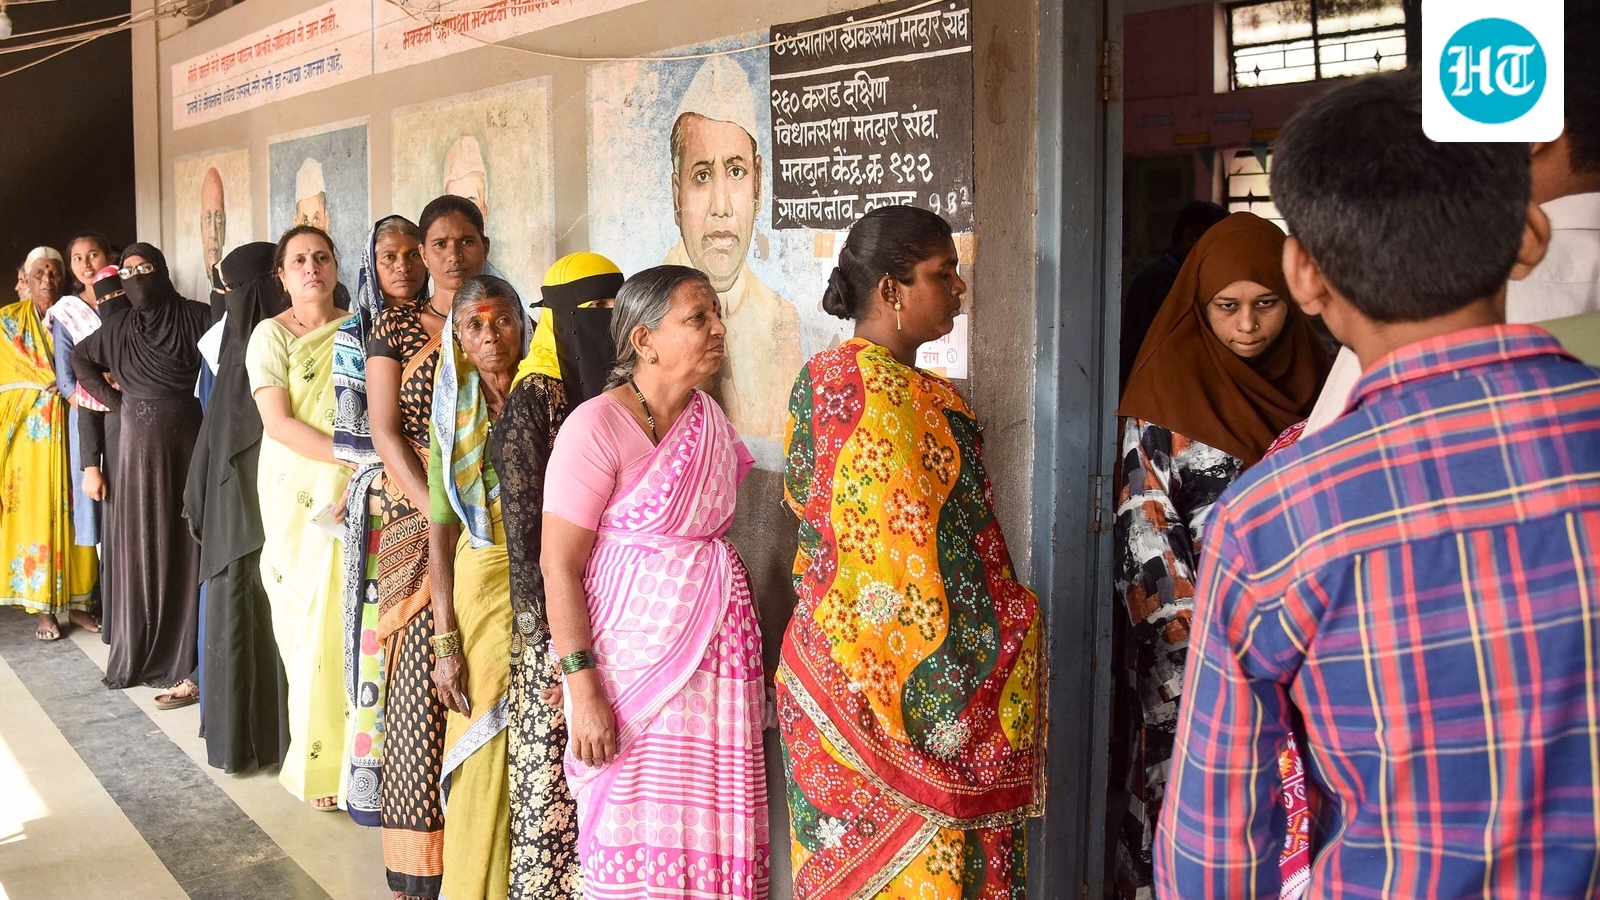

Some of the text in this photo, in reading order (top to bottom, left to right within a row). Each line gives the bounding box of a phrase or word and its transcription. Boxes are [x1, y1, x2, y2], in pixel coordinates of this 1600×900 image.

[840, 16, 899, 53] लोकसभा
[900, 10, 942, 48] मतदार
[942, 3, 970, 41] संघ
[771, 70, 890, 119] २६० कराड दक्षिण
[774, 117, 850, 147] विधानसभा
[851, 112, 901, 146] मतदार
[779, 156, 831, 188] मतदान
[889, 152, 934, 184] १२२
